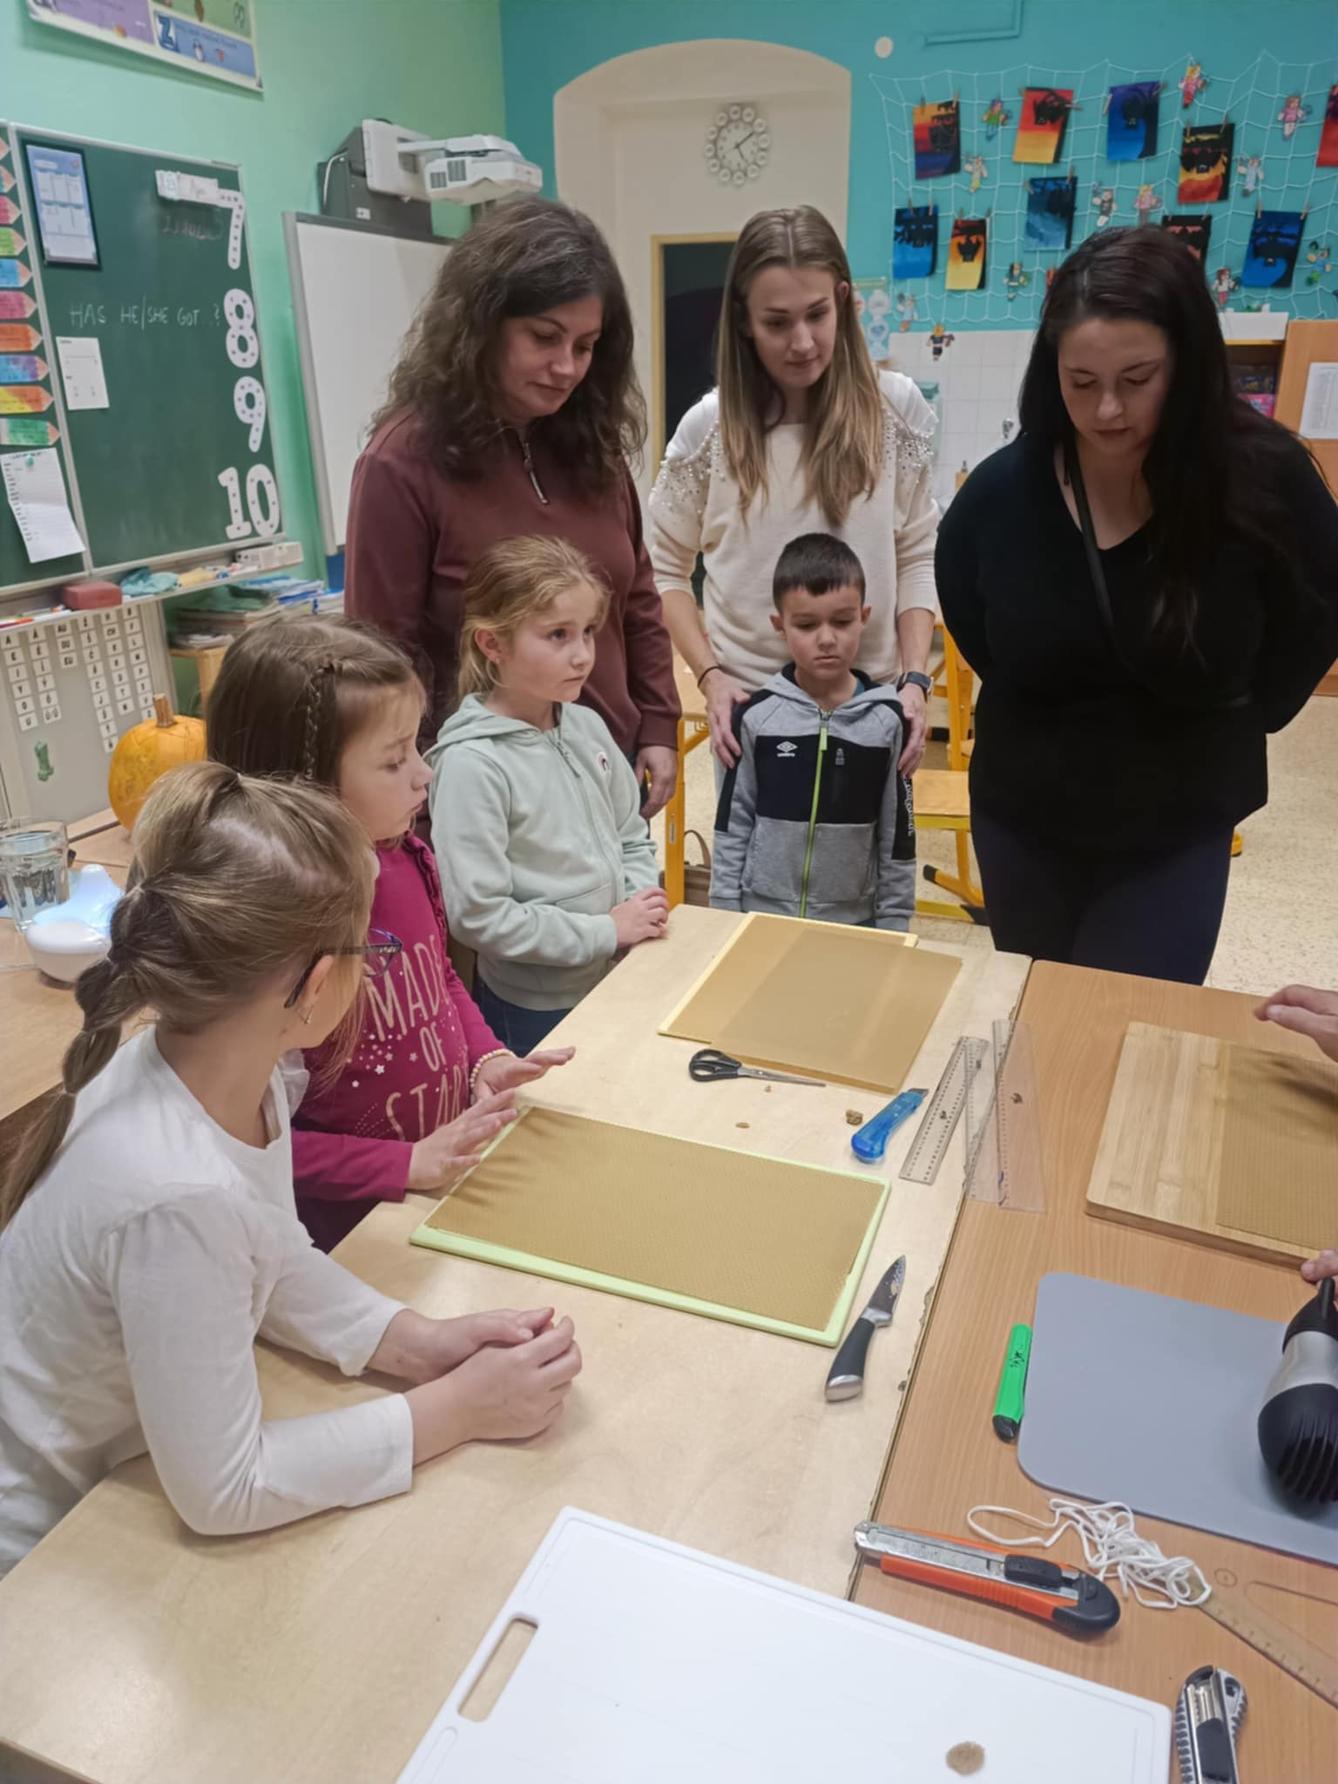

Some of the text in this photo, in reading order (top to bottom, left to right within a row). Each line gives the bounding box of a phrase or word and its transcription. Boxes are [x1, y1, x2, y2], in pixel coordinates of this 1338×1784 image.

[70, 303, 106, 328] HAS
[120, 296, 168, 330] HE/SHE
[177, 307, 200, 326] GOT
[223, 288, 259, 369] 8
[233, 376, 266, 453] 9
[217, 463, 281, 540] 10
[419, 1021, 447, 1072] OF
